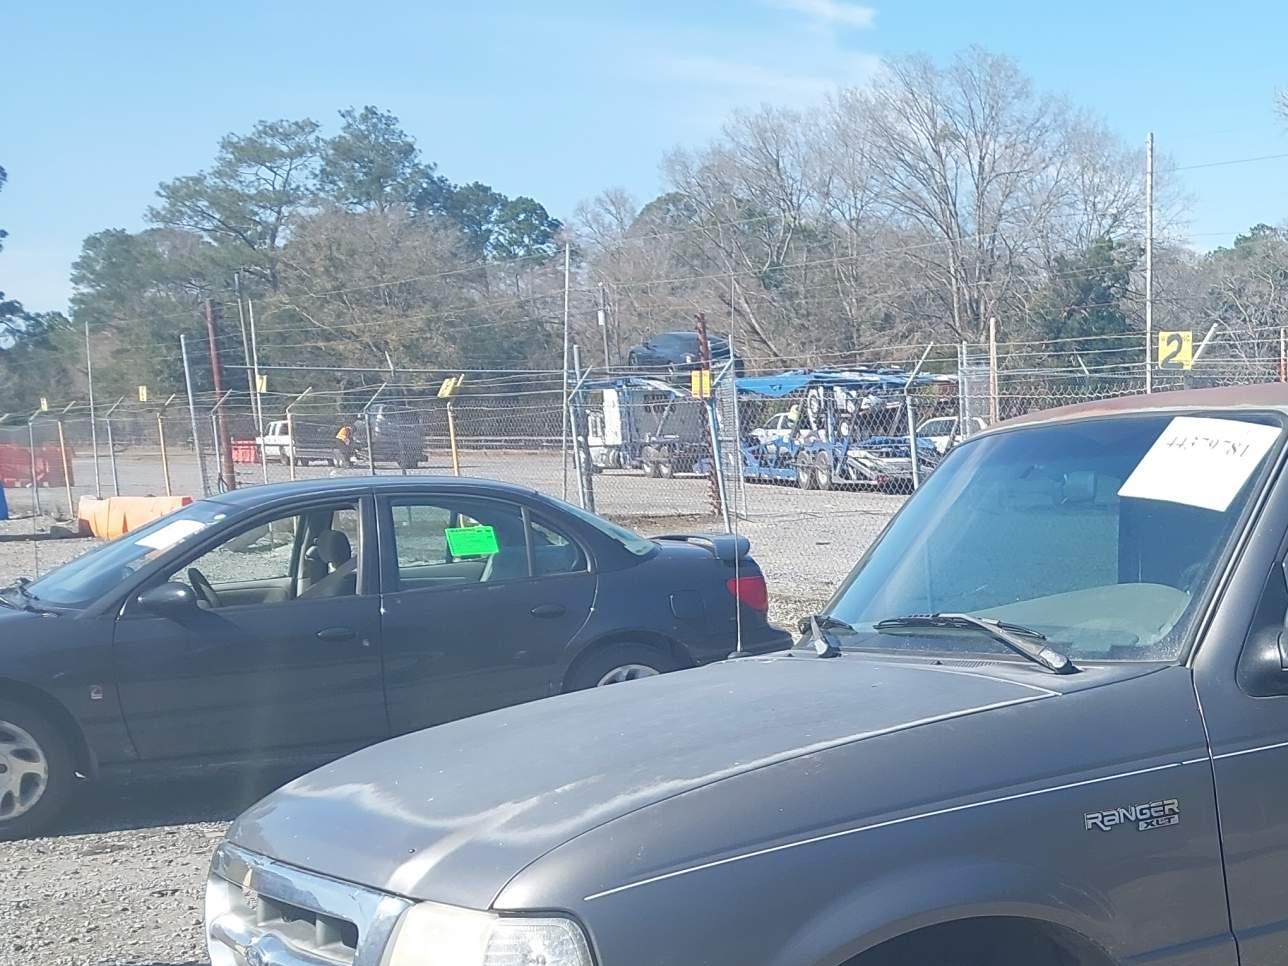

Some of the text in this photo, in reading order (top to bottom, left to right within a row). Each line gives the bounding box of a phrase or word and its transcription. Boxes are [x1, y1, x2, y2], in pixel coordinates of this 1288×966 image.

[1160, 333, 1184, 370] 2
[1084, 799, 1180, 831] RANGER
[1141, 814, 1178, 830] XLT
